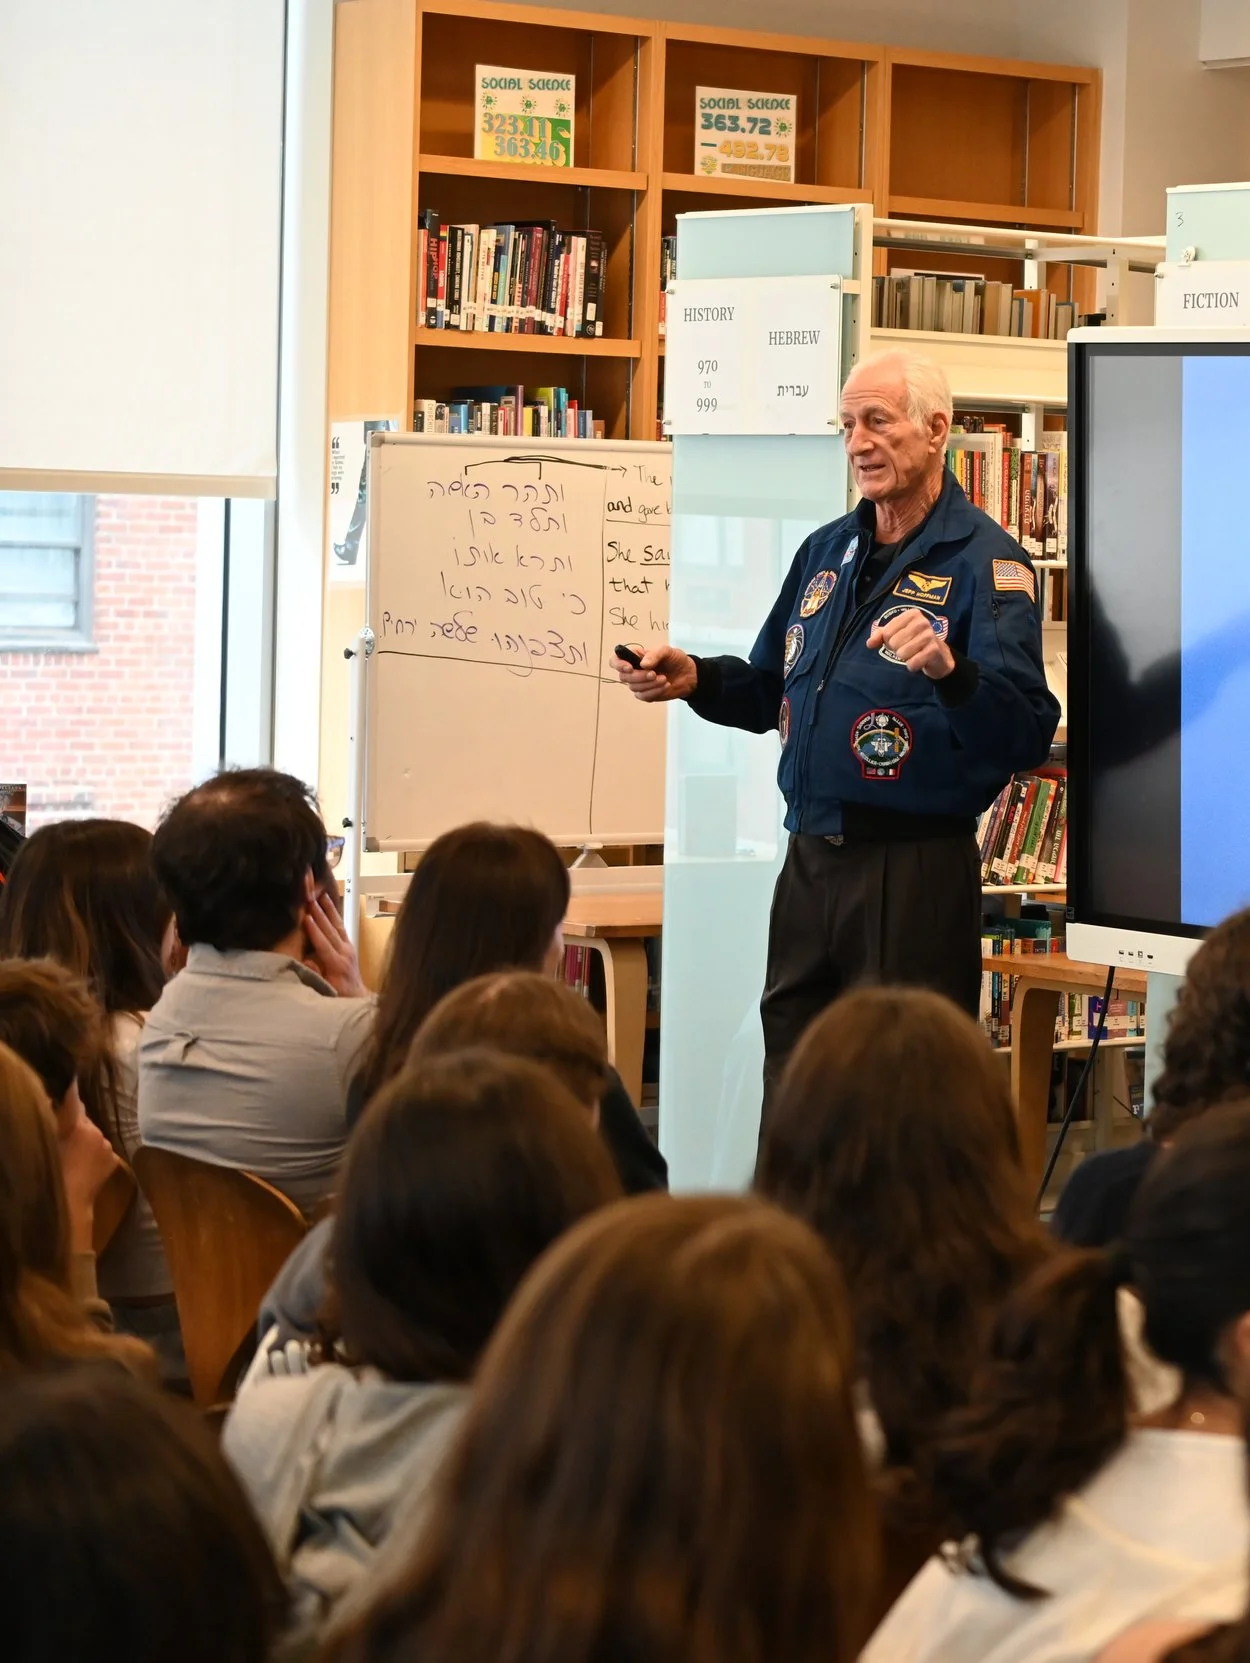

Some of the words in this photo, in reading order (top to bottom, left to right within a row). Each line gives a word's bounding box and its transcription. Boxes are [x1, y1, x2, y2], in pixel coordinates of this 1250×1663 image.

[481, 77, 523, 90] SOCIAL
[528, 79, 571, 91] SCIENCE
[699, 97, 742, 110] SOCIAL
[747, 98, 791, 110] SCIENCE
[482, 112, 547, 139] 323.11
[701, 112, 772, 136] 363.72
[494, 136, 560, 161] 363.46
[1175, 212, 1185, 228] 3
[1183, 292, 1240, 309] FICTION
[683, 306, 735, 322] HISTORY
[768, 330, 821, 346] HEBREW
[697, 360, 718, 375] 970
[703, 380, 712, 389] TO
[776, 384, 809, 398] עברית
[696, 397, 718, 413] 999
[633, 465, 663, 486] The
[607, 496, 632, 513] and
[638, 503, 662, 523] gave
[607, 541, 637, 563] She
[609, 576, 654, 594] that
[916, 592, 941, 600] HOFFMAN
[609, 606, 639, 631] She
